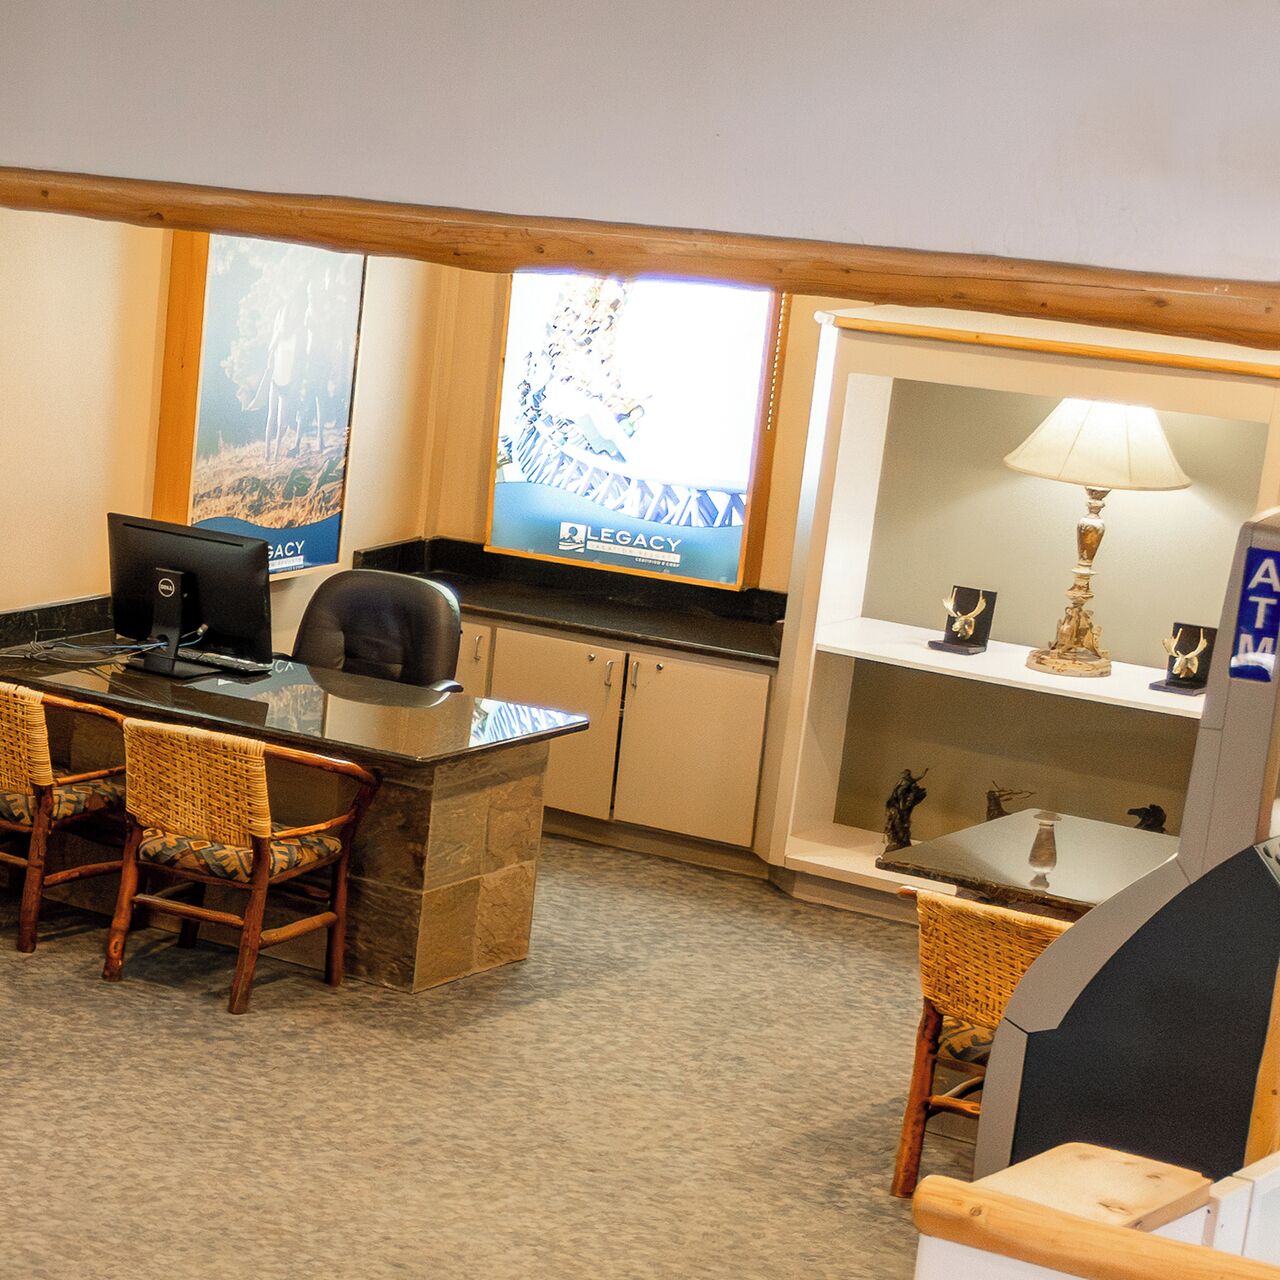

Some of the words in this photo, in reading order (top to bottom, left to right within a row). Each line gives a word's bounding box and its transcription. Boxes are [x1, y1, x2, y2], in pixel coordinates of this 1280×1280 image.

[267, 540, 305, 559] GACY
[587, 526, 681, 552] LEGACY
[1238, 558, 1280, 665] ATM
